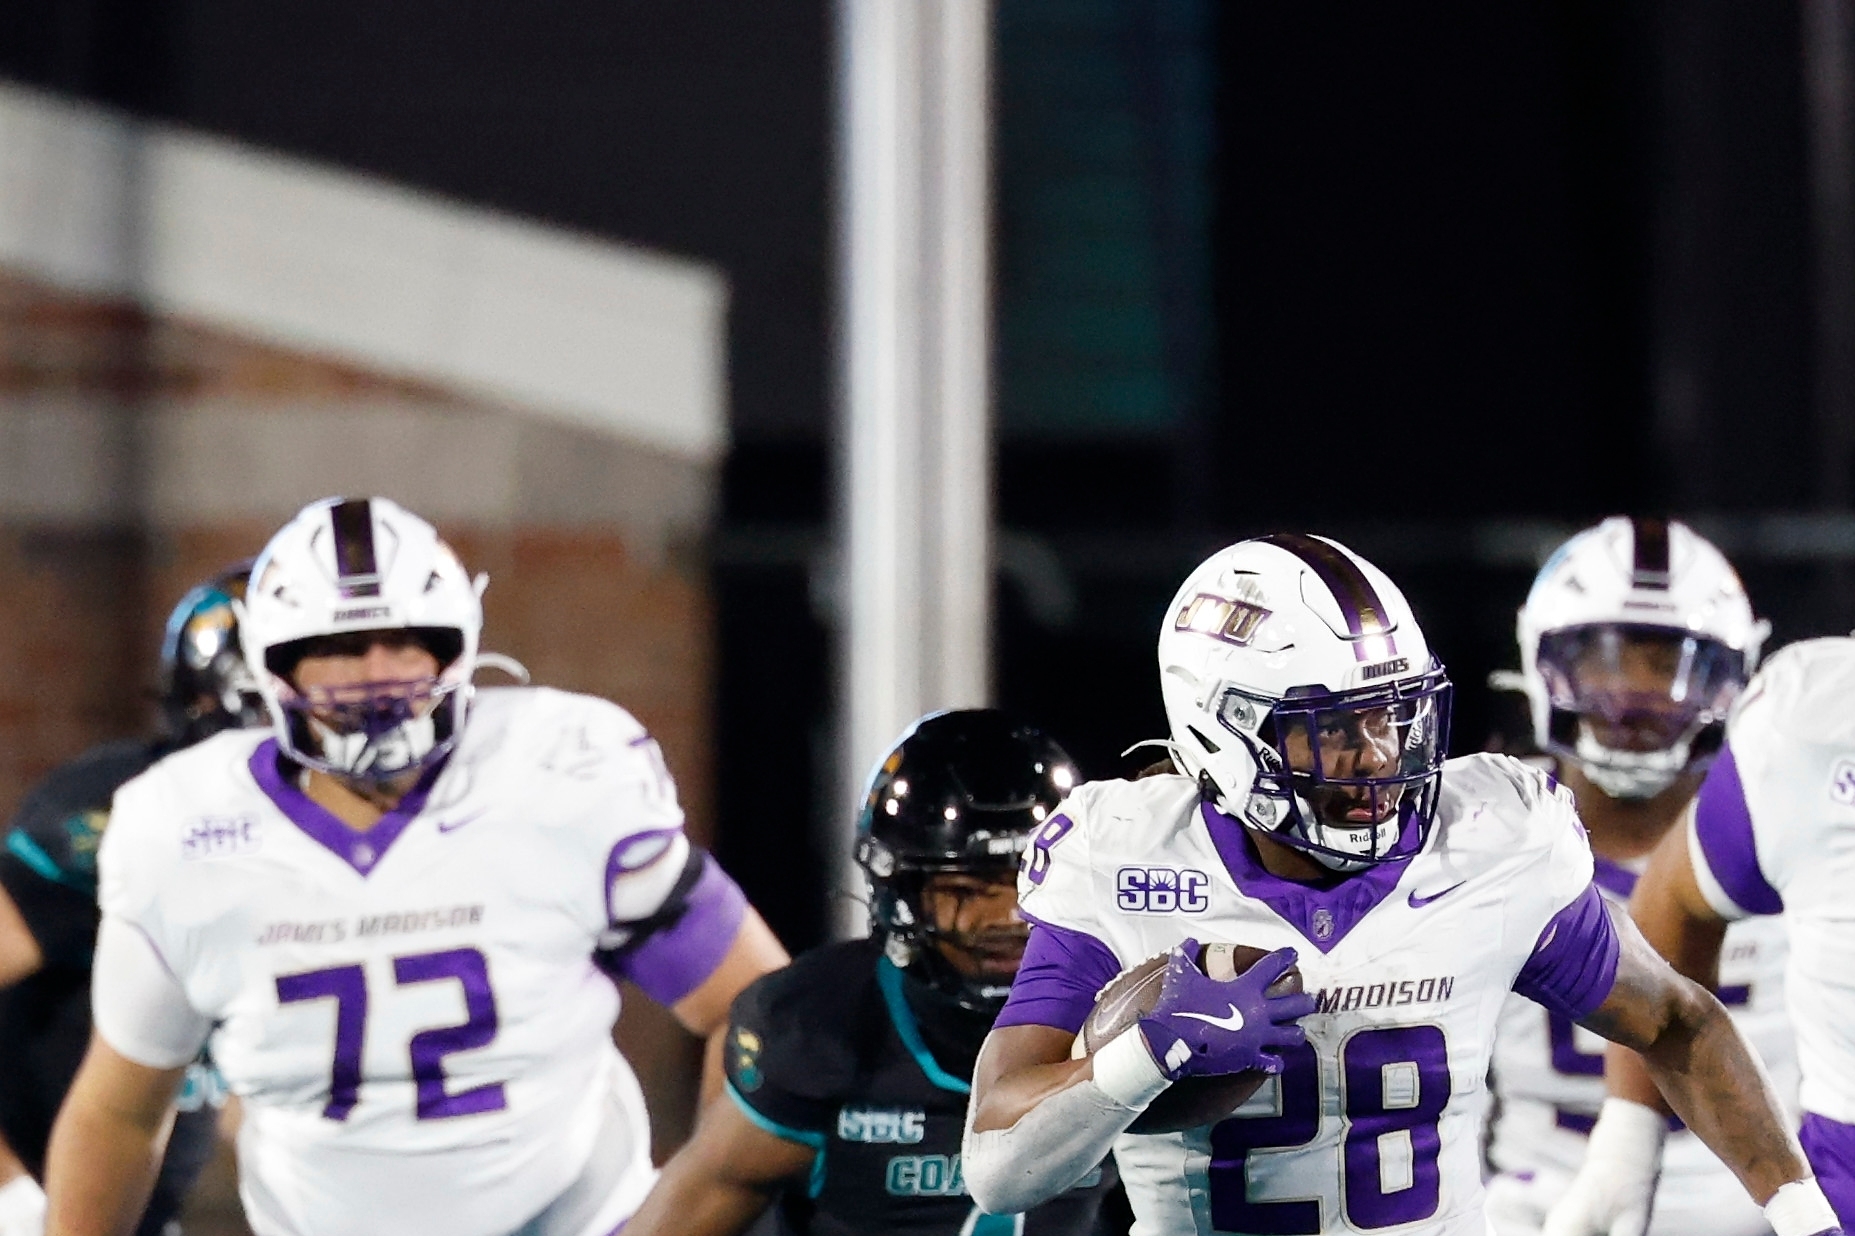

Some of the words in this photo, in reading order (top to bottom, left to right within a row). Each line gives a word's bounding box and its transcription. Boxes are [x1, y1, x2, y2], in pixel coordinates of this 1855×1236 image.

[1116, 866, 1209, 913] SBC
[275, 947, 506, 1122] 72
[1316, 976, 1455, 1014] MADISON
[1208, 1022, 1453, 1236] 28
